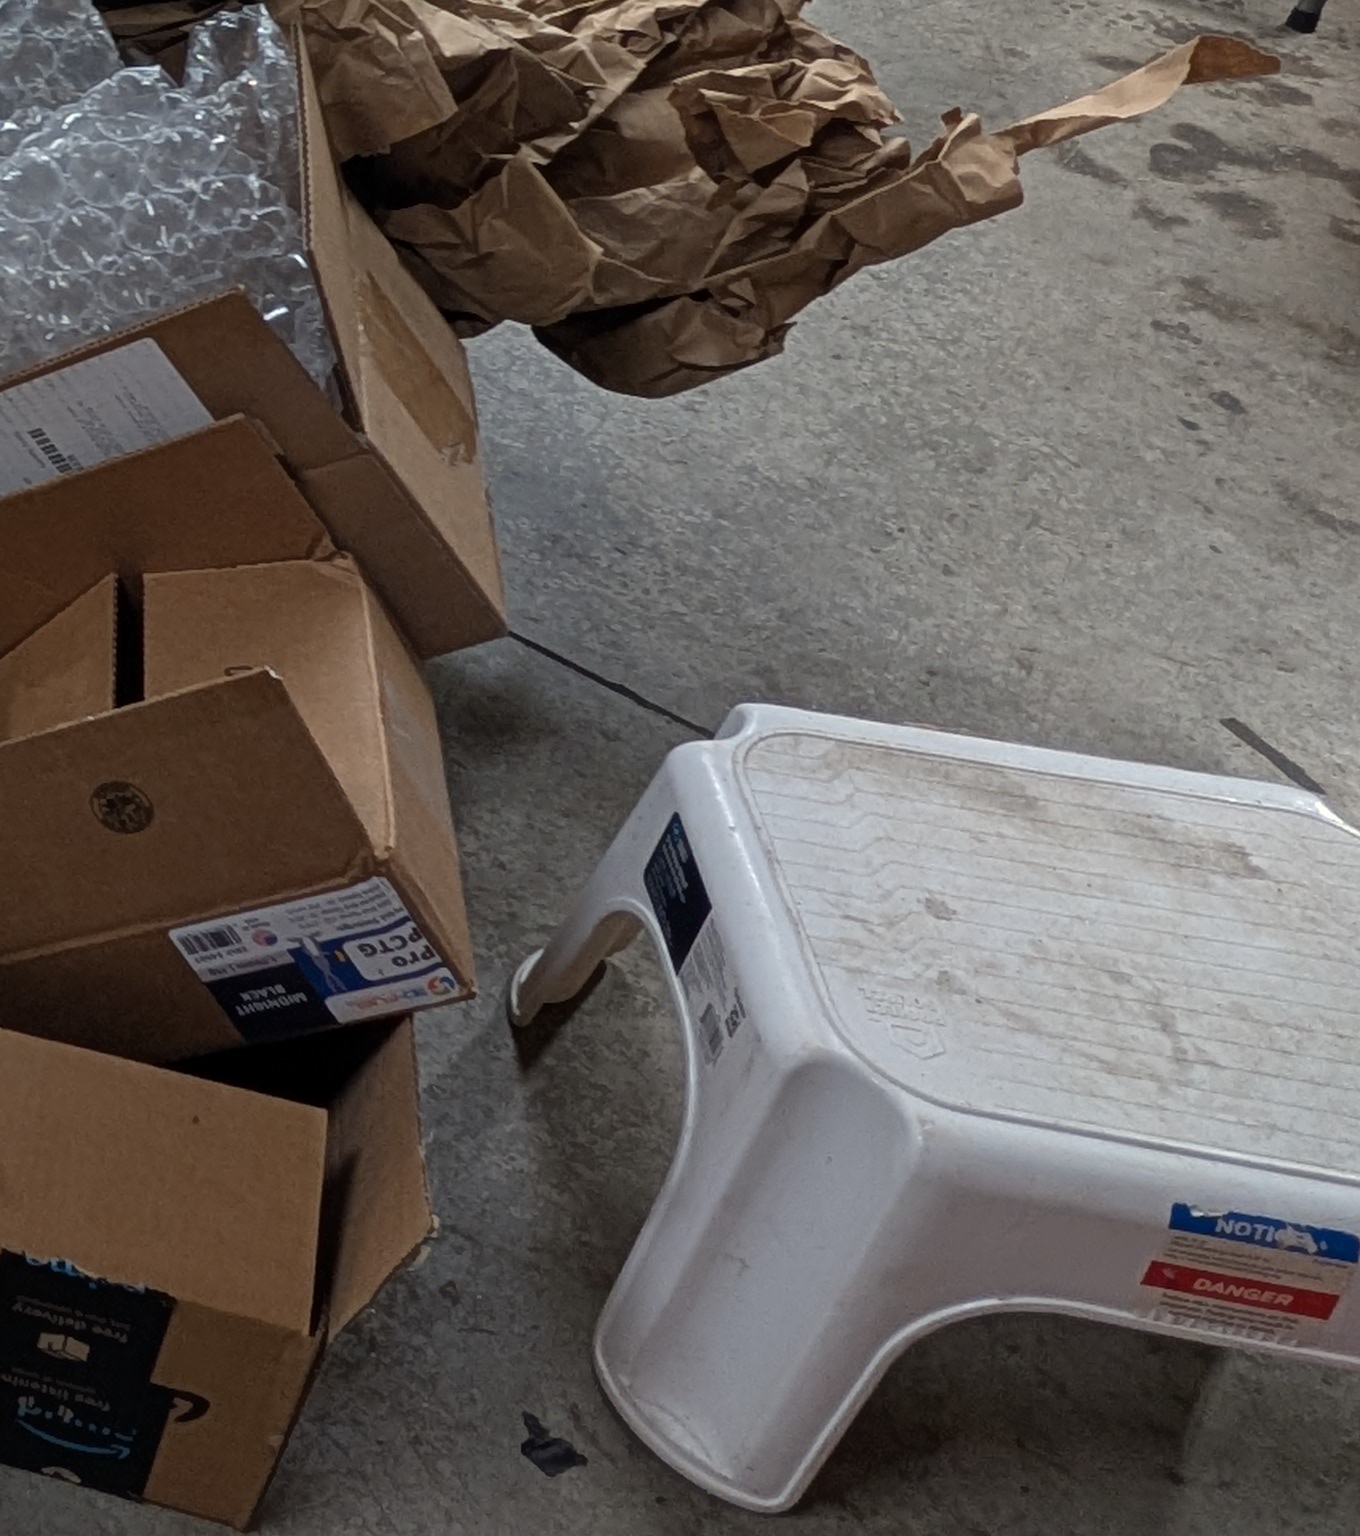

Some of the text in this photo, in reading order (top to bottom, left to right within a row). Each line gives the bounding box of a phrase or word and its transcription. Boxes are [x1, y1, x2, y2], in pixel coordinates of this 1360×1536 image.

[360, 927, 423, 957] PCTG
[392, 945, 436, 968] Pro
[234, 992, 309, 1017] MIDNIGHT
[239, 983, 286, 1003] BLACK
[1193, 1277, 1295, 1307] DANGER
